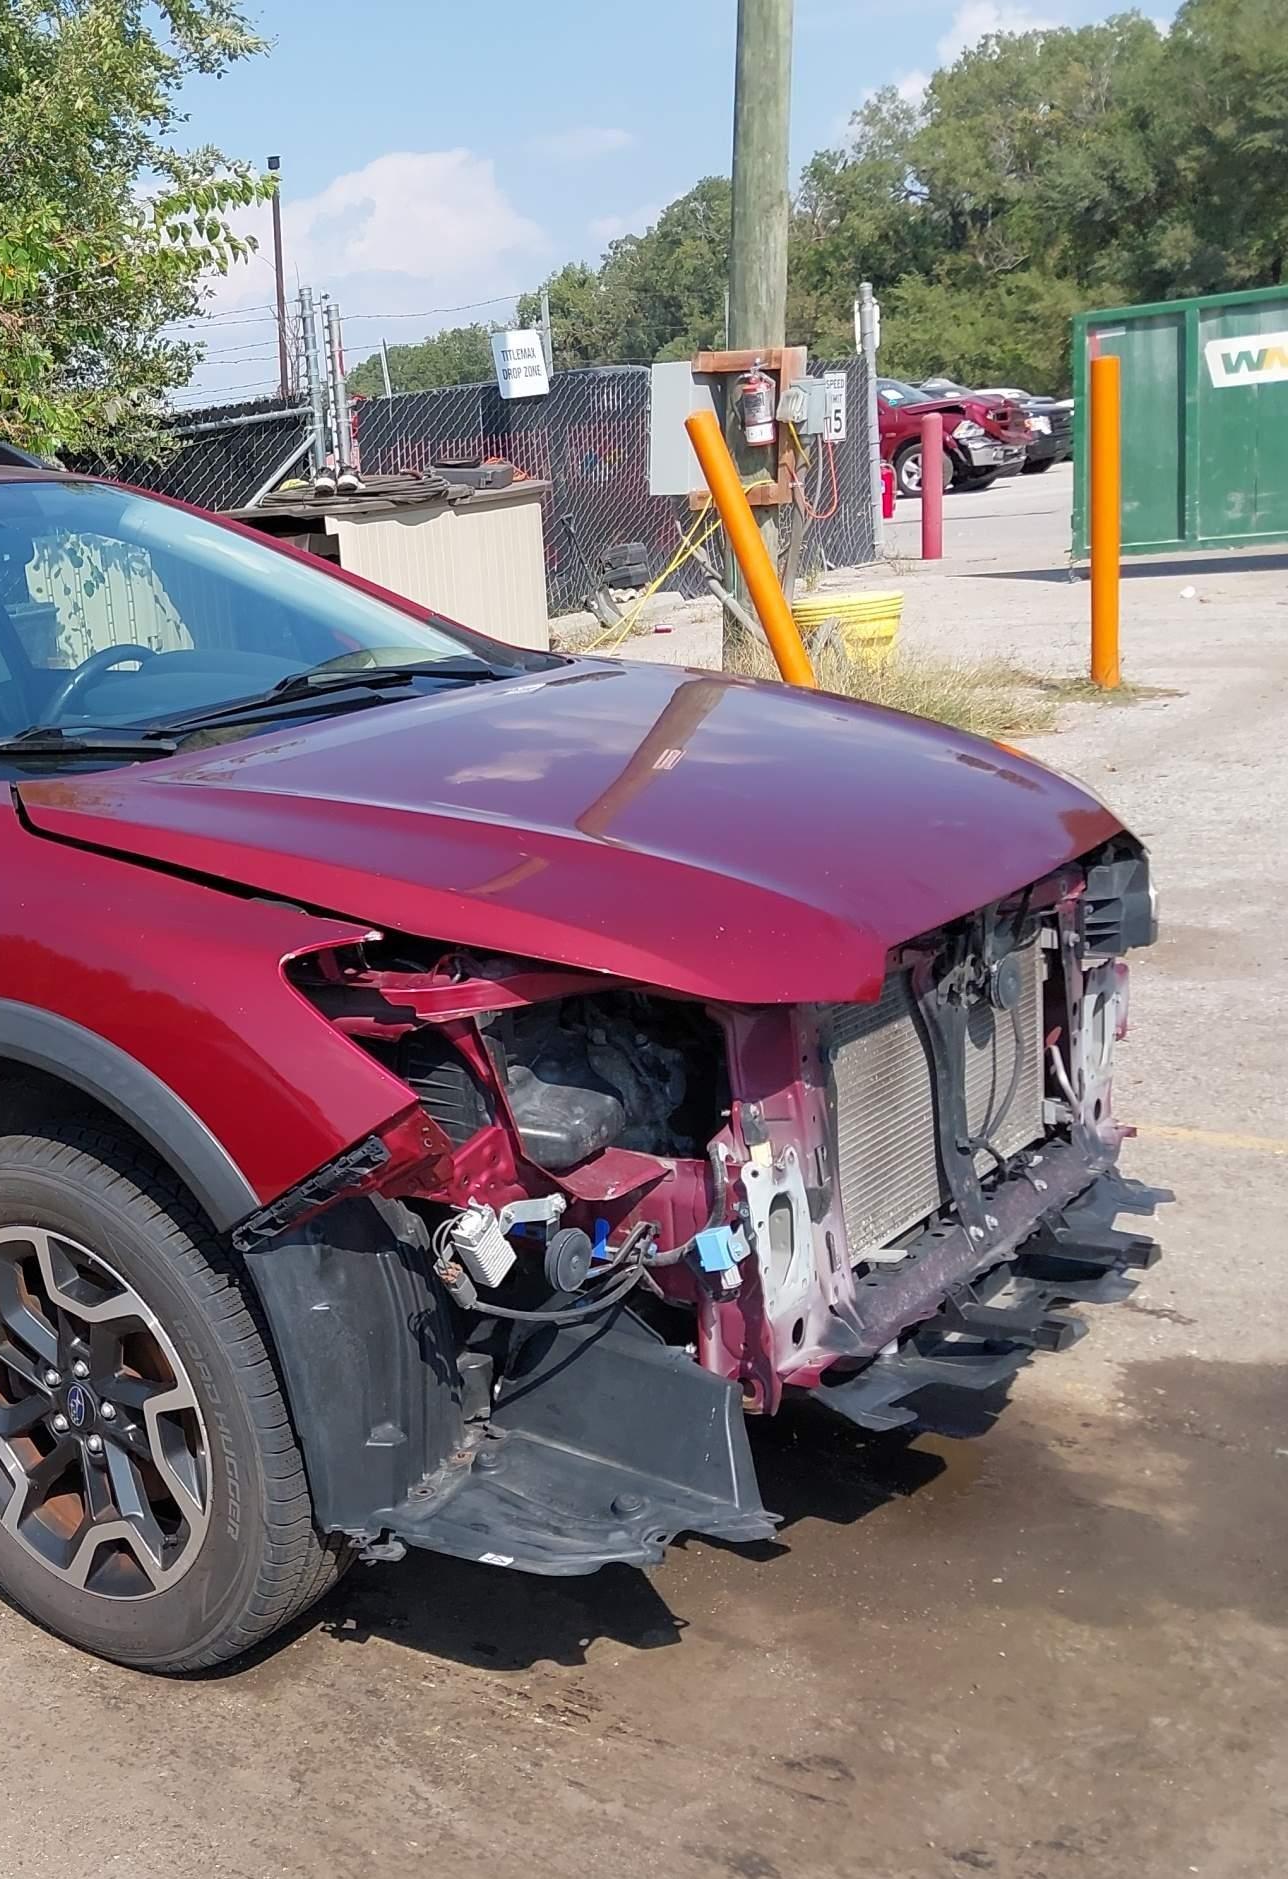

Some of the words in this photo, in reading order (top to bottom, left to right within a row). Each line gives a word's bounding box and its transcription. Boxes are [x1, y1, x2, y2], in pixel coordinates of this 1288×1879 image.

[501, 347, 536, 362] TITLEMAX
[502, 367, 522, 381] DROP
[523, 364, 543, 377] ZONE
[826, 379, 844, 389] SPEED
[173, 1319, 221, 1404] ROAD
[214, 1411, 241, 1541] HUGGER
